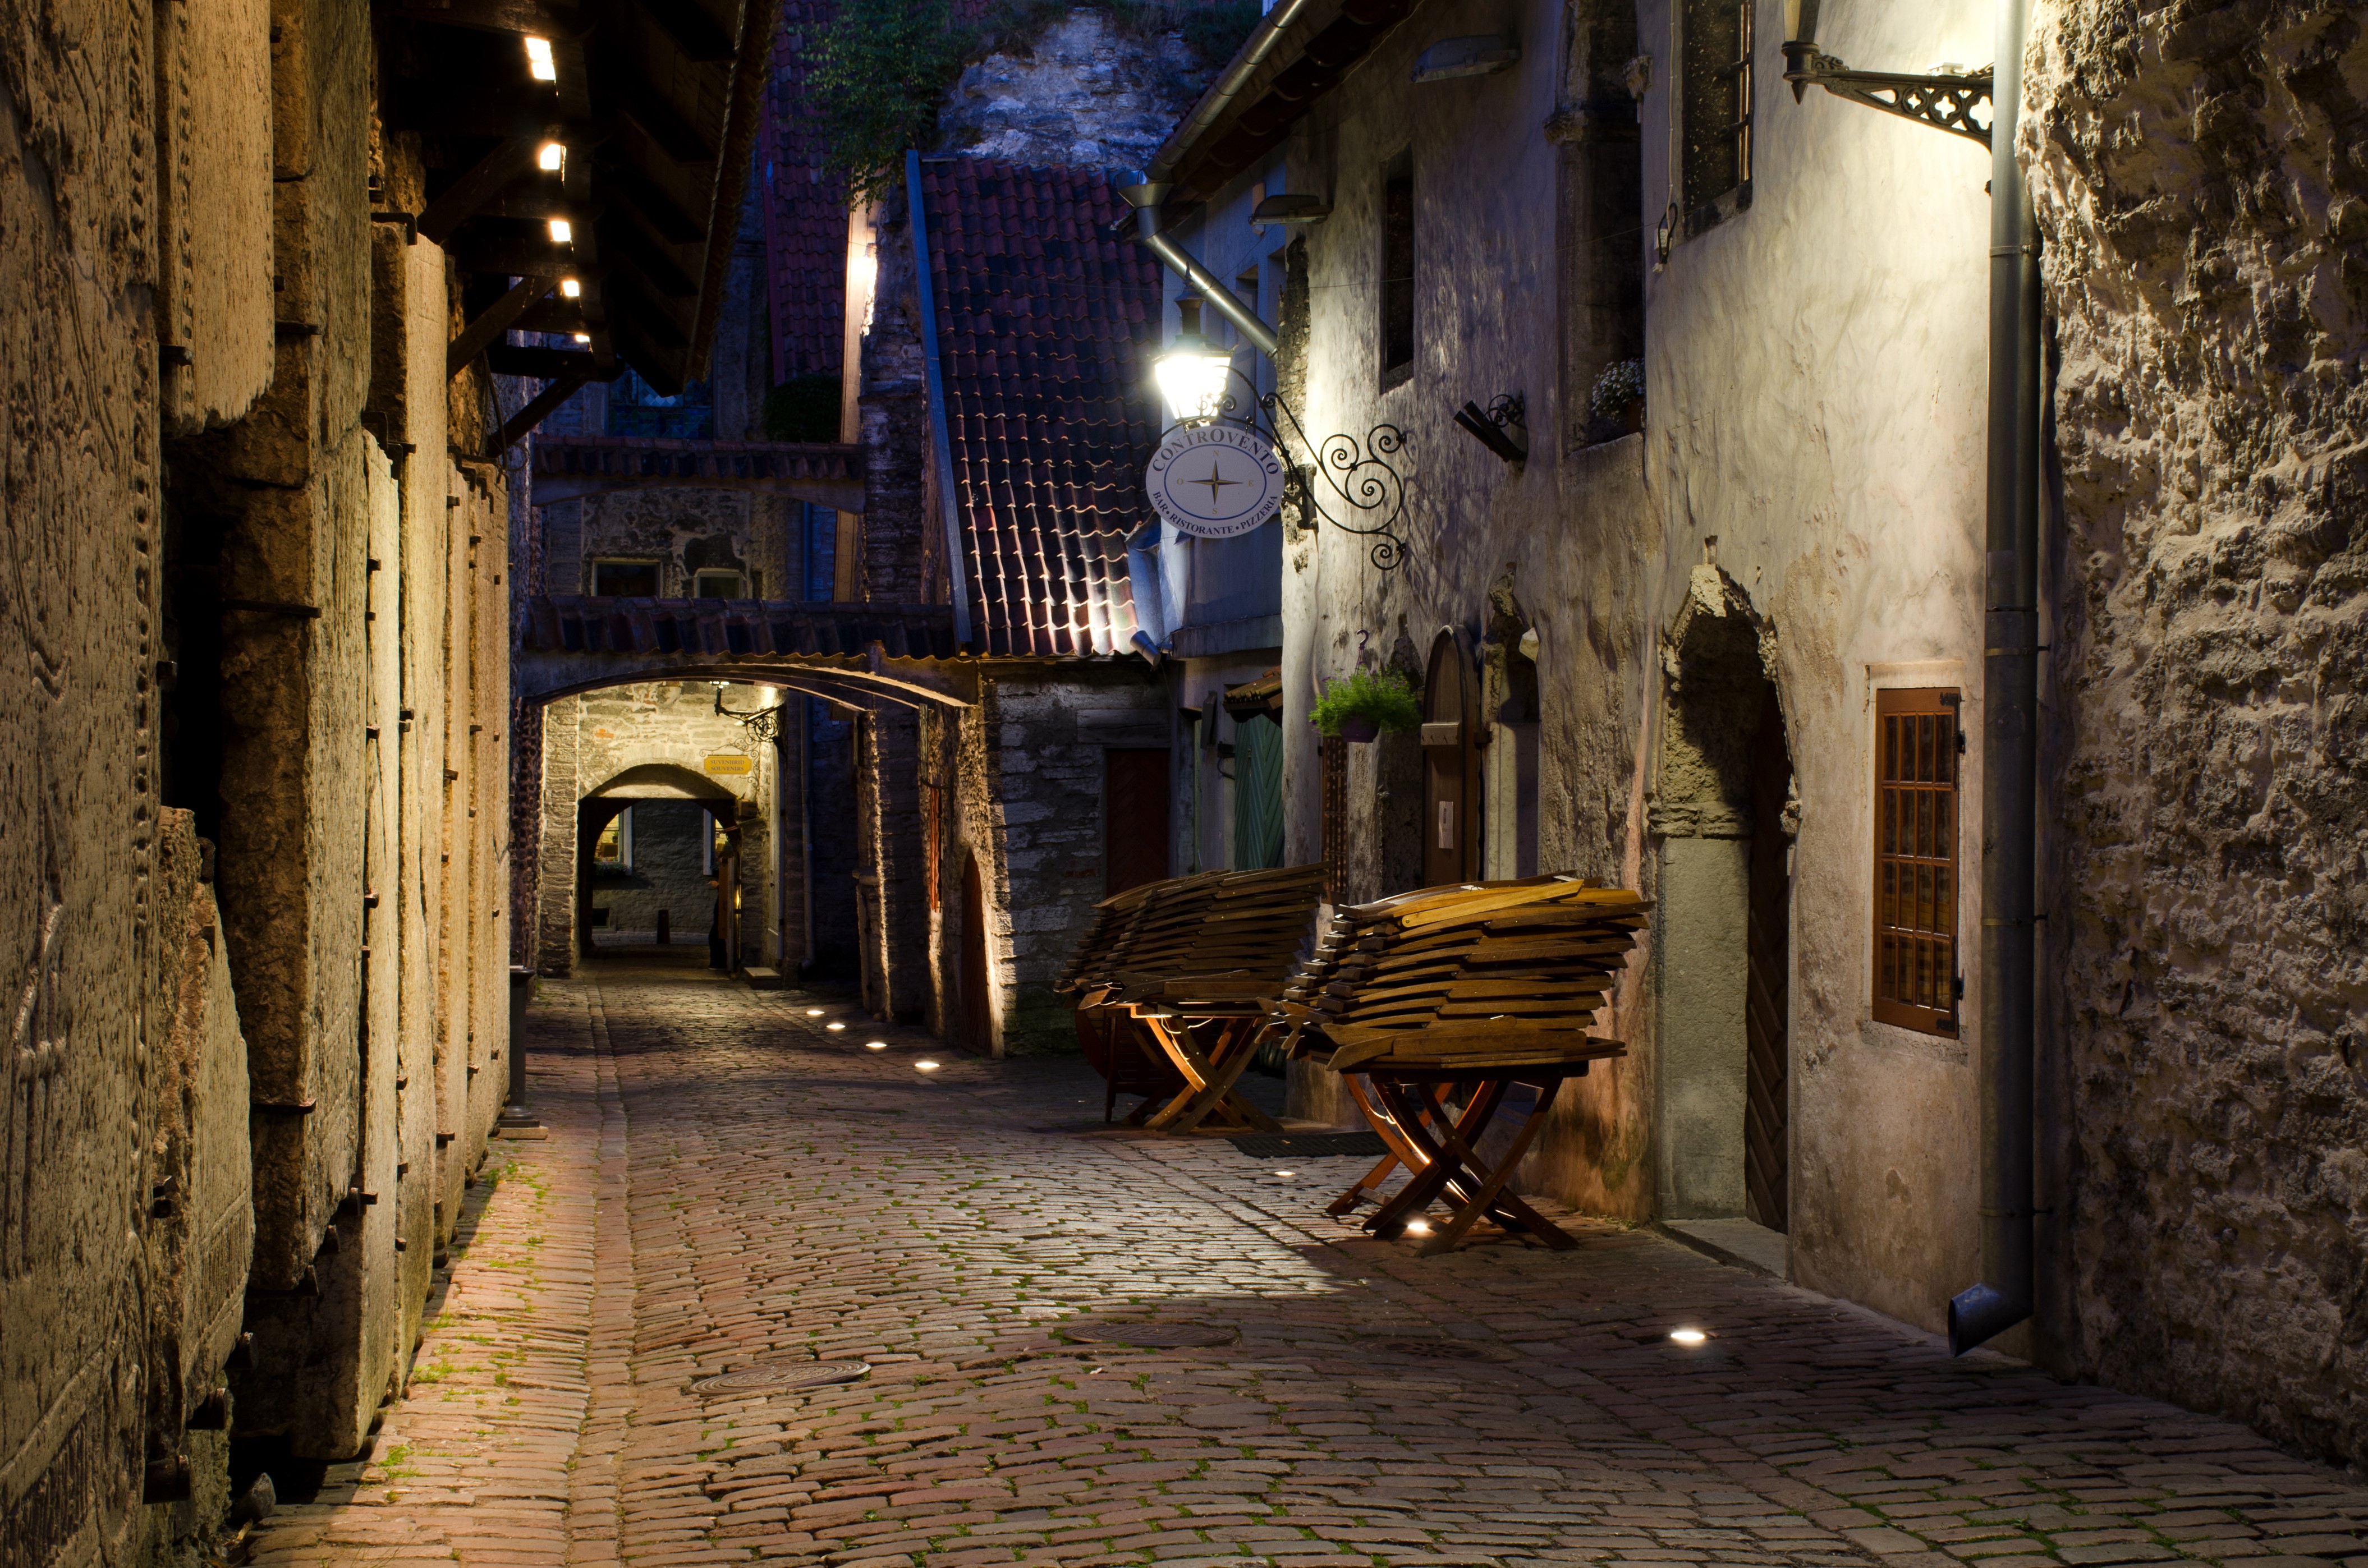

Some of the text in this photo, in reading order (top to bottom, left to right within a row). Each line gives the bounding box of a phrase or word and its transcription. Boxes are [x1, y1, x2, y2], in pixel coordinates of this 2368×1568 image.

[1153, 429, 1279, 475] CONTROVENTO
[1153, 491, 1278, 535] BAR RISTORANTE PIZZERIA
